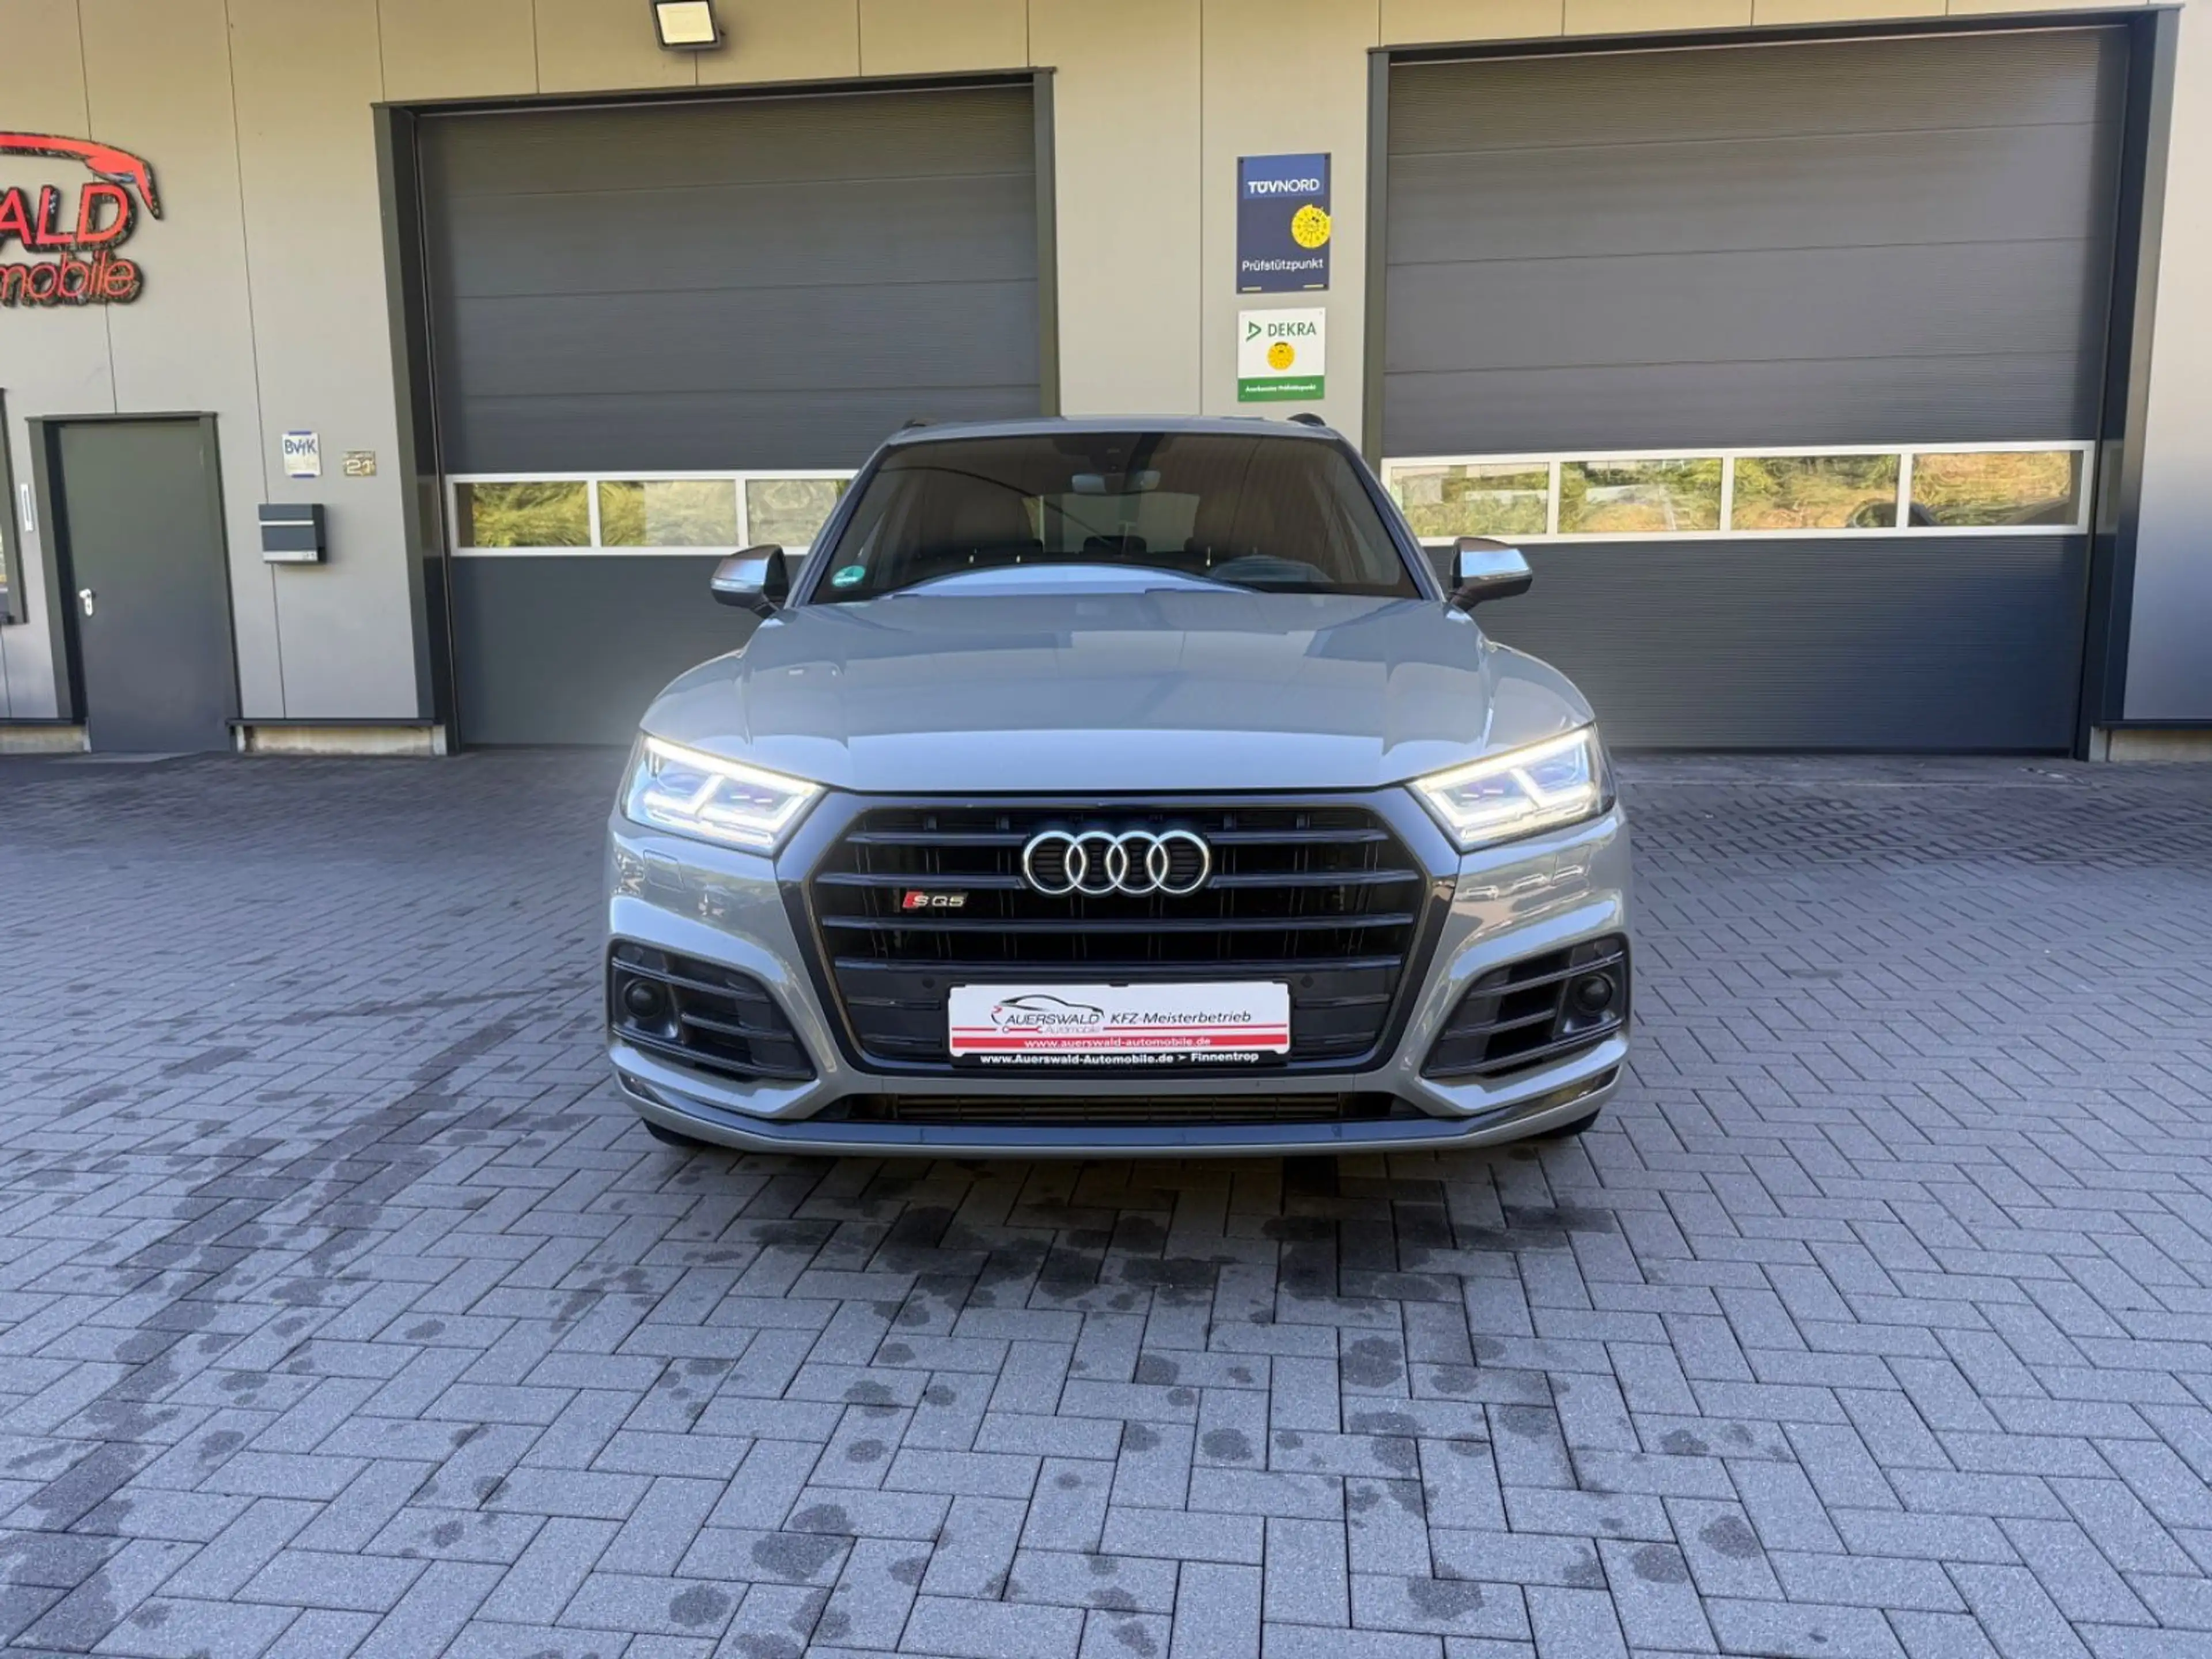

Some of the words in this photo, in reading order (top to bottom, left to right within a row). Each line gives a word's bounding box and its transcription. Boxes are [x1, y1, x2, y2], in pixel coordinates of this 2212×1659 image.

[1242, 257, 1324, 272] Prüfstützpunkt
[1267, 321, 1317, 337] DEKRA
[1005, 1012, 1100, 1026] AUERSWALD
[1110, 1010, 1252, 1025] KFZ-Meisterbetrieb
[1023, 1037, 1211, 1049] www.auerswald-automobile.de
[980, 1052, 1175, 1065] www.Auerswald-Automobile.de
[1191, 1051, 1259, 1062] Finnentrop
